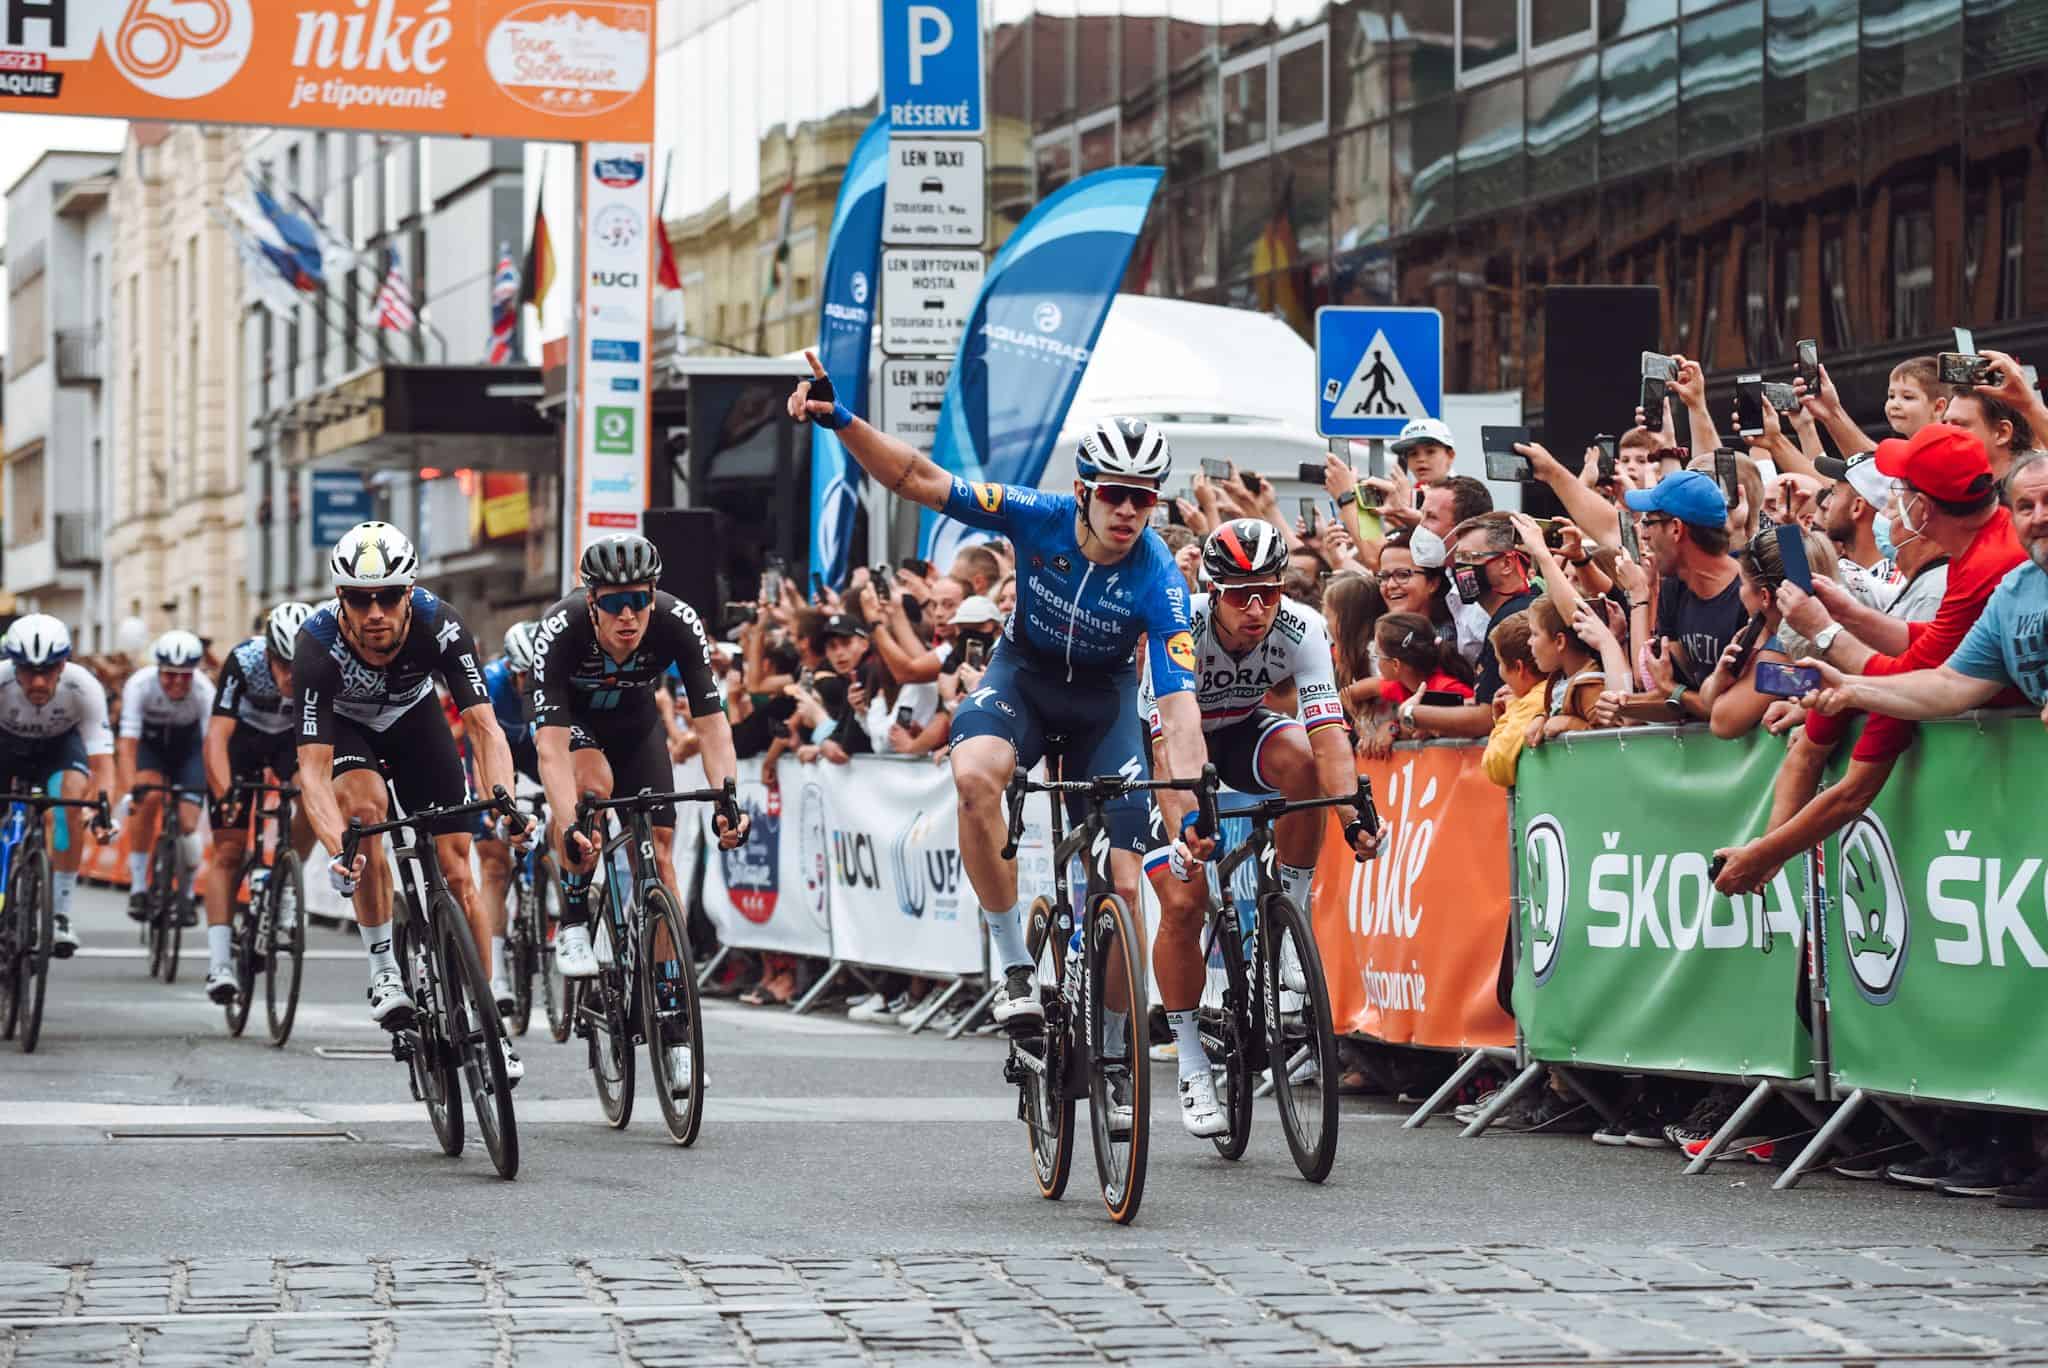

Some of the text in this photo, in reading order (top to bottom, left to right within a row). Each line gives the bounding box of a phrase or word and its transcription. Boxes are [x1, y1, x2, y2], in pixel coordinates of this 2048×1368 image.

[291, 0, 453, 74] niké
[907, 5, 953, 86] P
[287, 76, 448, 110] je tipovanie
[891, 101, 969, 126] RÉSERVÉ
[901, 150, 964, 167] LEN TAXI
[600, 271, 639, 288] UCI
[888, 259, 909, 271] LEN
[892, 370, 917, 386] LEN
[1028, 575, 1122, 634] deceuninck
[533, 609, 570, 683] zoover
[458, 653, 489, 698] BMC
[1201, 666, 1273, 693] BORA
[302, 688, 320, 737] BMC
[926, 848, 962, 894] UE
[1926, 829, 2048, 969] ŠK
